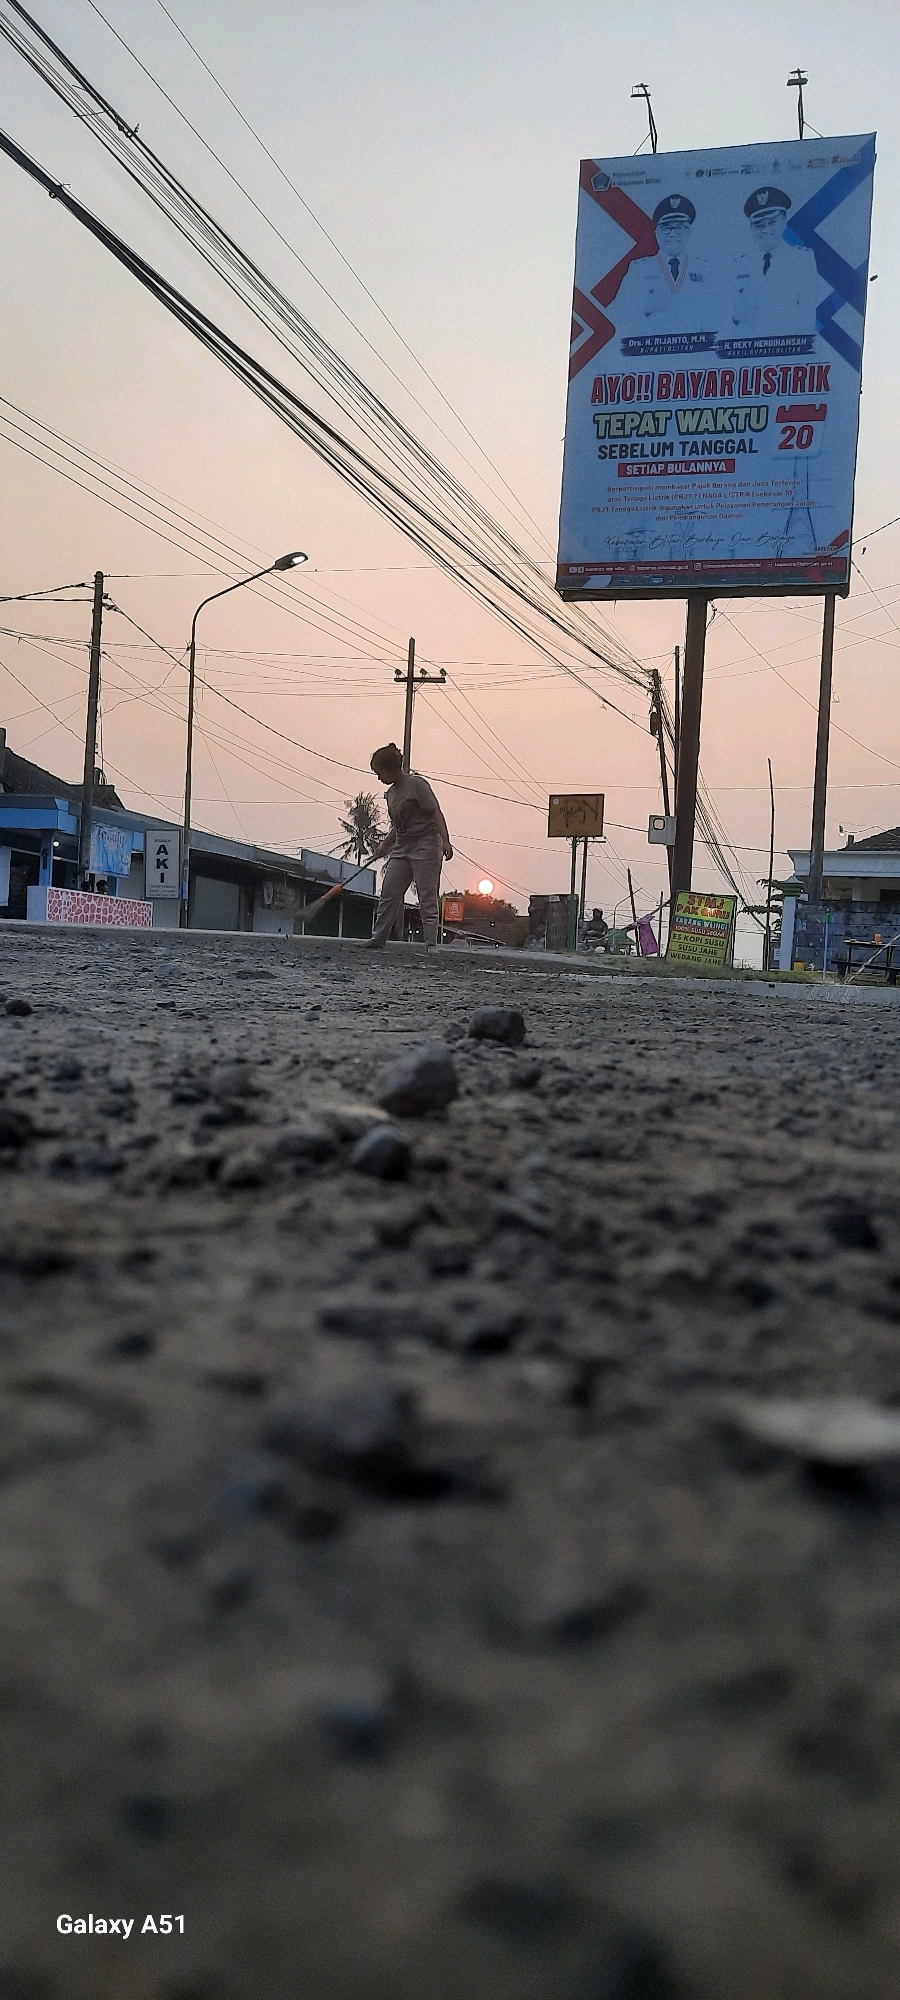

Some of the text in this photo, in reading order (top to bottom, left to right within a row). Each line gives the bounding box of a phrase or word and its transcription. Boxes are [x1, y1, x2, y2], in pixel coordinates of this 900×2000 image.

[628, 335, 708, 347] Drs. H. RIJANTO, M.M.
[724, 338, 807, 351] H. BEKY HERDIHANSAH
[590, 364, 831, 404] AYO!! BAYAR LISTRIK
[594, 405, 768, 438] TEPAT WAKTU
[778, 425, 814, 449] 20
[598, 438, 758, 459] SEBELUM TANGGAL
[626, 460, 727, 475] SETIAP BULANNYA
[608, 485, 654, 493] Berpartisipasi
[623, 495, 647, 503] Tenaga
[648, 493, 670, 501] Listrik
[671, 493, 691, 501] (PBJT
[693, 492, 722, 500] TENAGA
[724, 491, 755, 499] LISTRIK)
[658, 503, 693, 511] digunakan
[670, 513, 717, 521] Pembangunan
[604, 532, 797, 551] Kabupaten Blitar Berdaya Dan Berjaya
[156, 844, 170, 884] AKI
[687, 895, 725, 909] STMJ
[676, 904, 730, 919] PAK GURU
[690, 927, 706, 935] SUSU
[683, 935, 703, 943] KOPI
[704, 938, 724, 947] SUSU
[678, 944, 718, 956] SUSU JAHE
[670, 952, 721, 966] WEDANG JAHE
